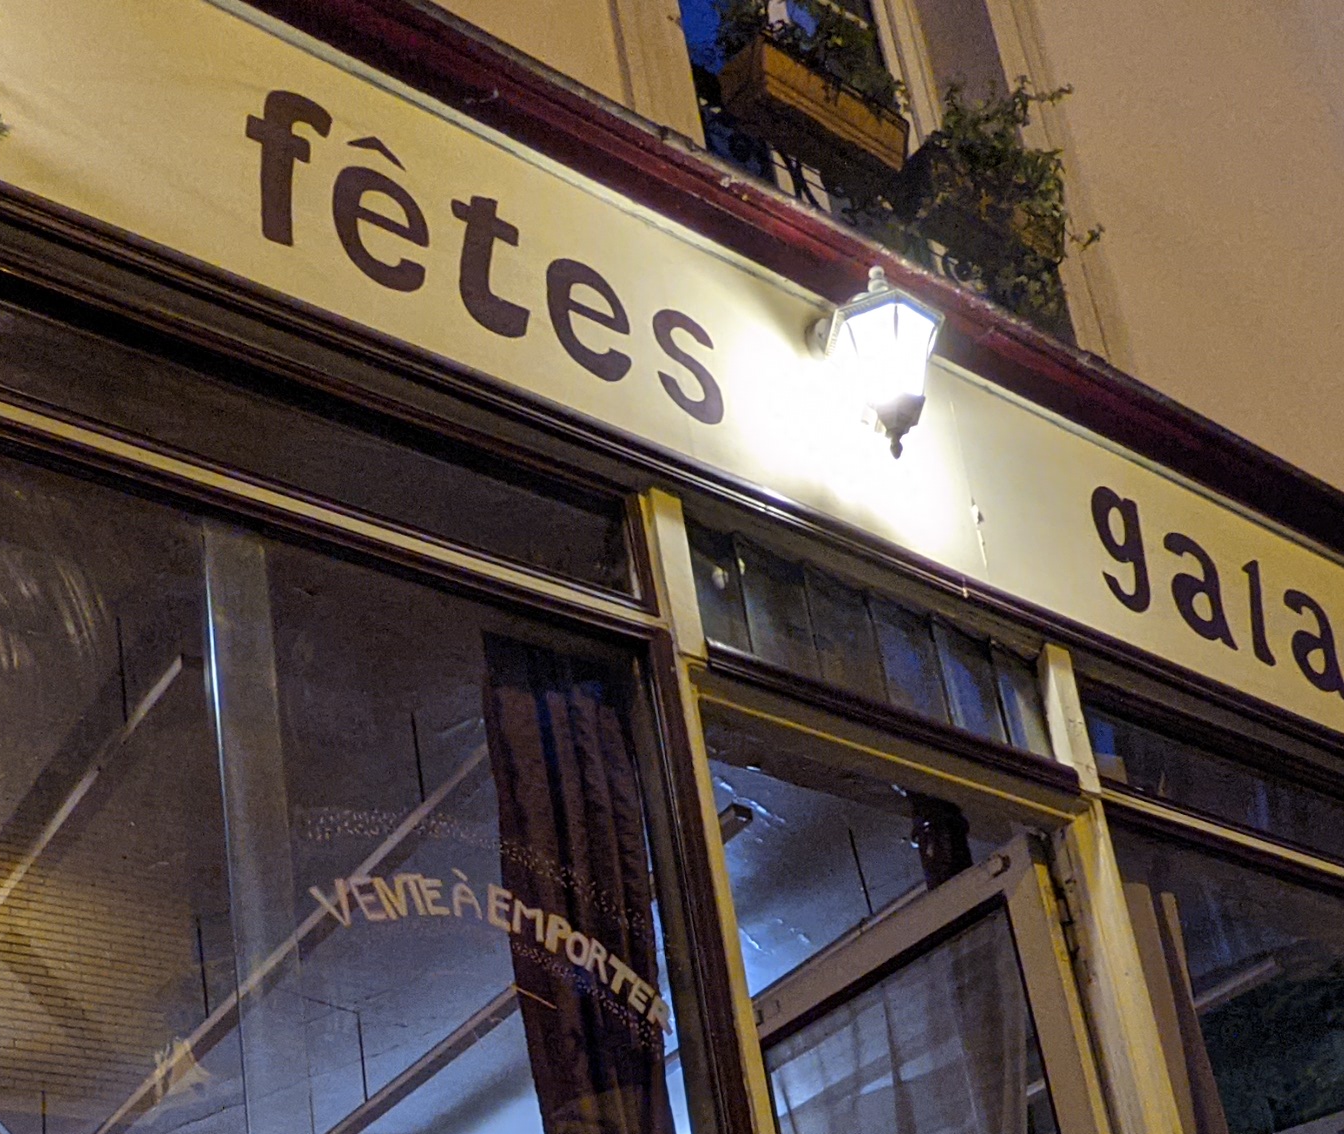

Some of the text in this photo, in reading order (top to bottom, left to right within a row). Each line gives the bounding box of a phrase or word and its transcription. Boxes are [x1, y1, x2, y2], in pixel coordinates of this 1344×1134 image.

[244, 89, 725, 426] fêtes
[308, 867, 675, 1037] VENTE À EMPORTER
